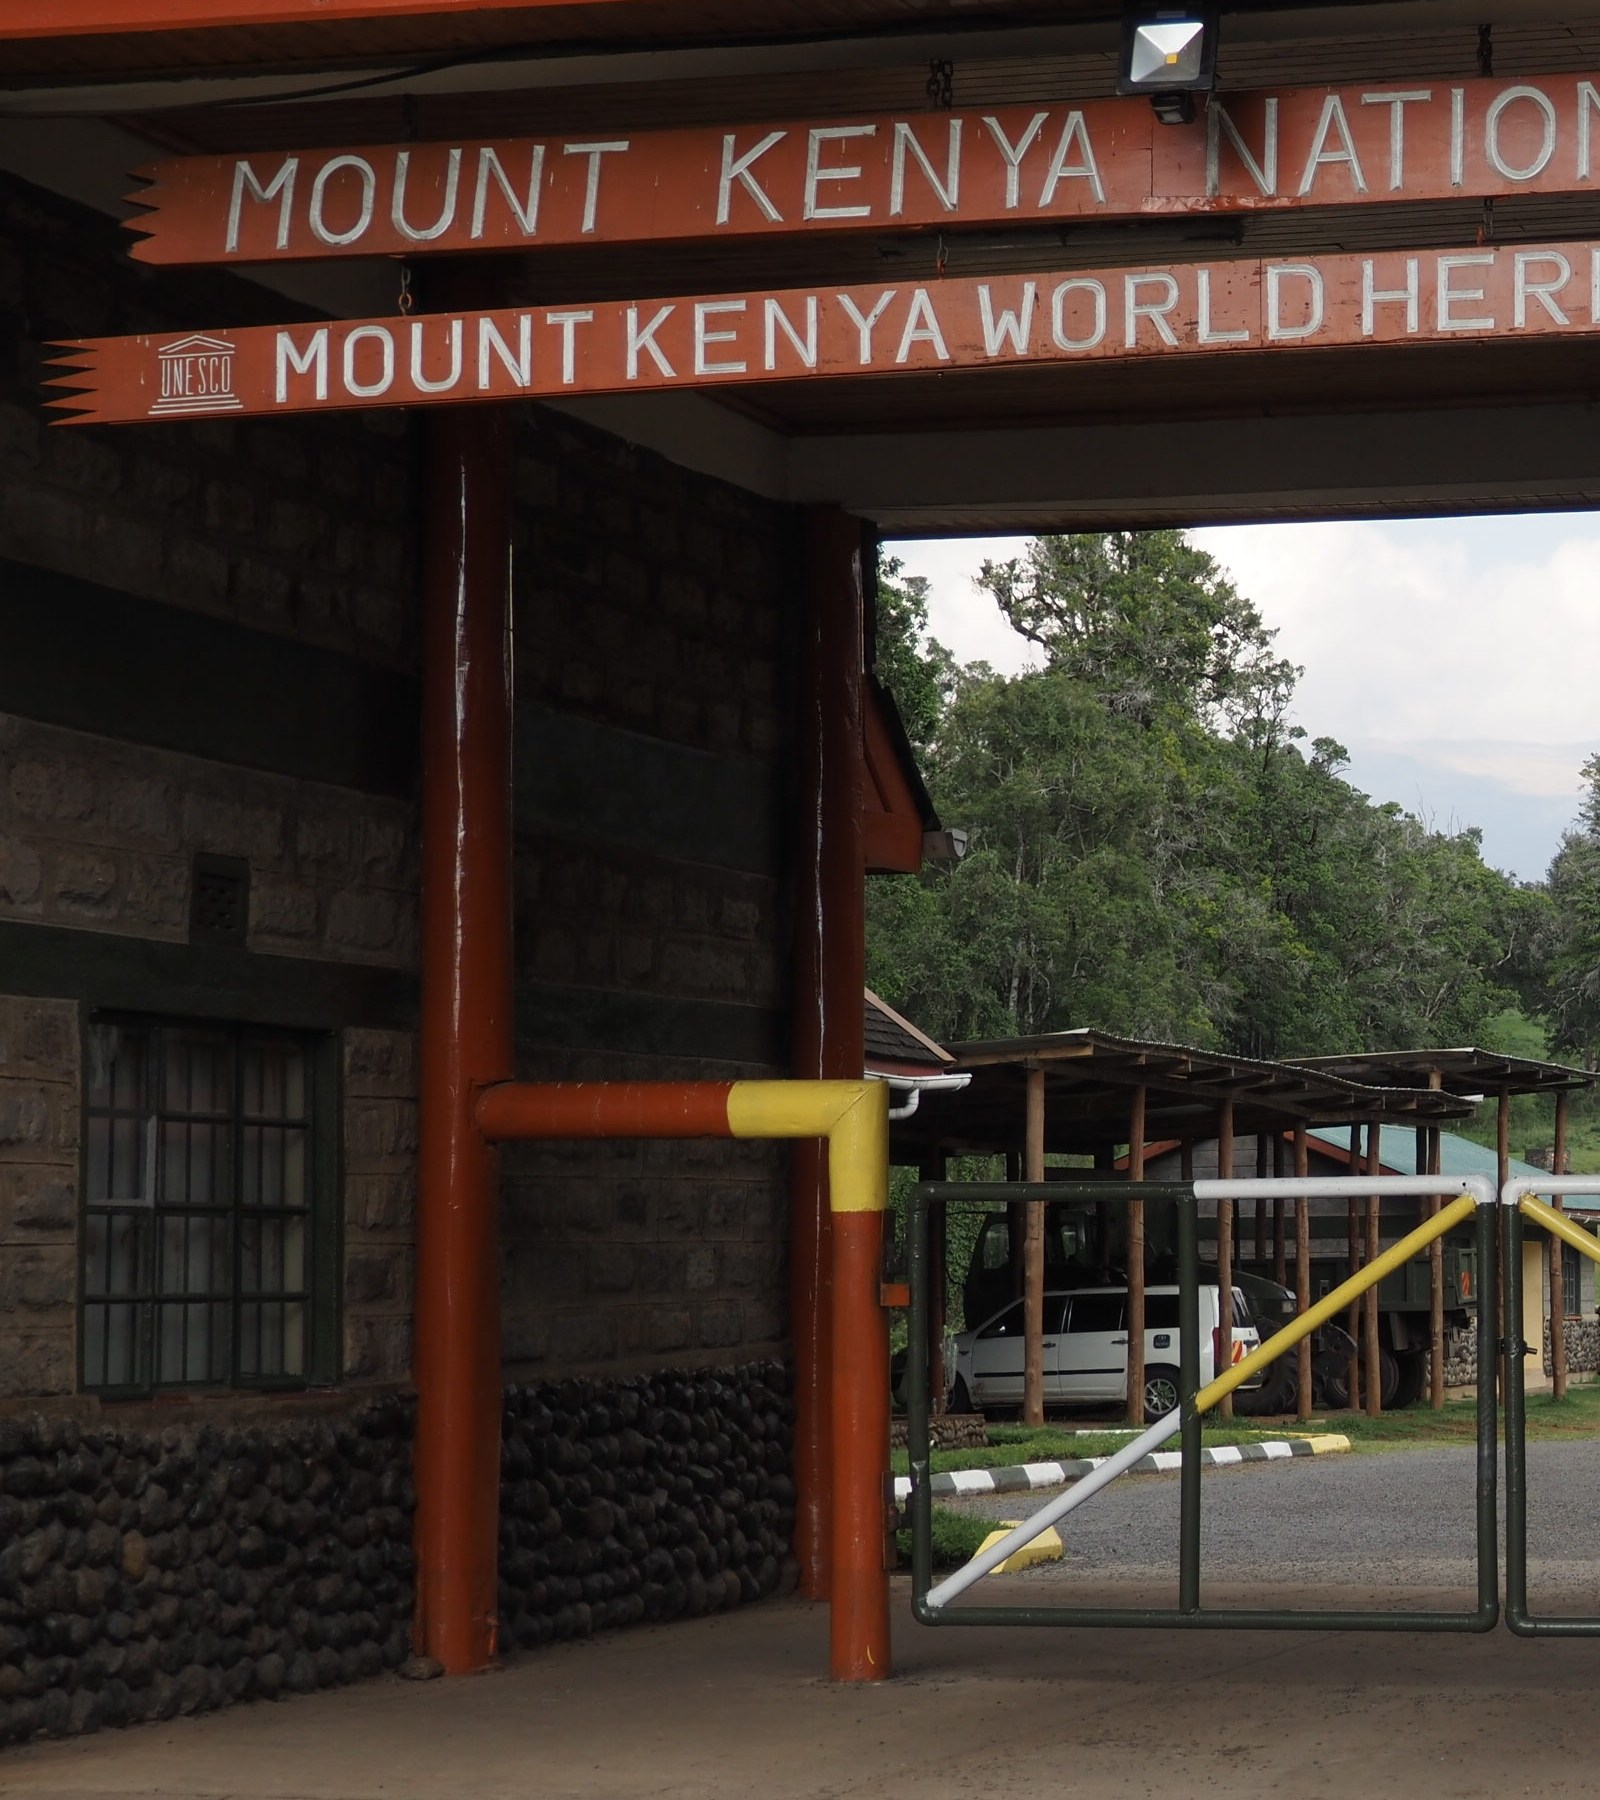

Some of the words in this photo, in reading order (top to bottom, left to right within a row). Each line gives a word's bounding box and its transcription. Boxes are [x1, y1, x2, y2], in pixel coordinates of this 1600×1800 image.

[225, 139, 630, 253] MOUNT
[716, 110, 1106, 226] KENYA
[160, 354, 232, 398] UNESCO
[275, 310, 593, 404] MOUNT
[626, 288, 950, 380] KENYA
[978, 263, 1325, 357] WORLD
